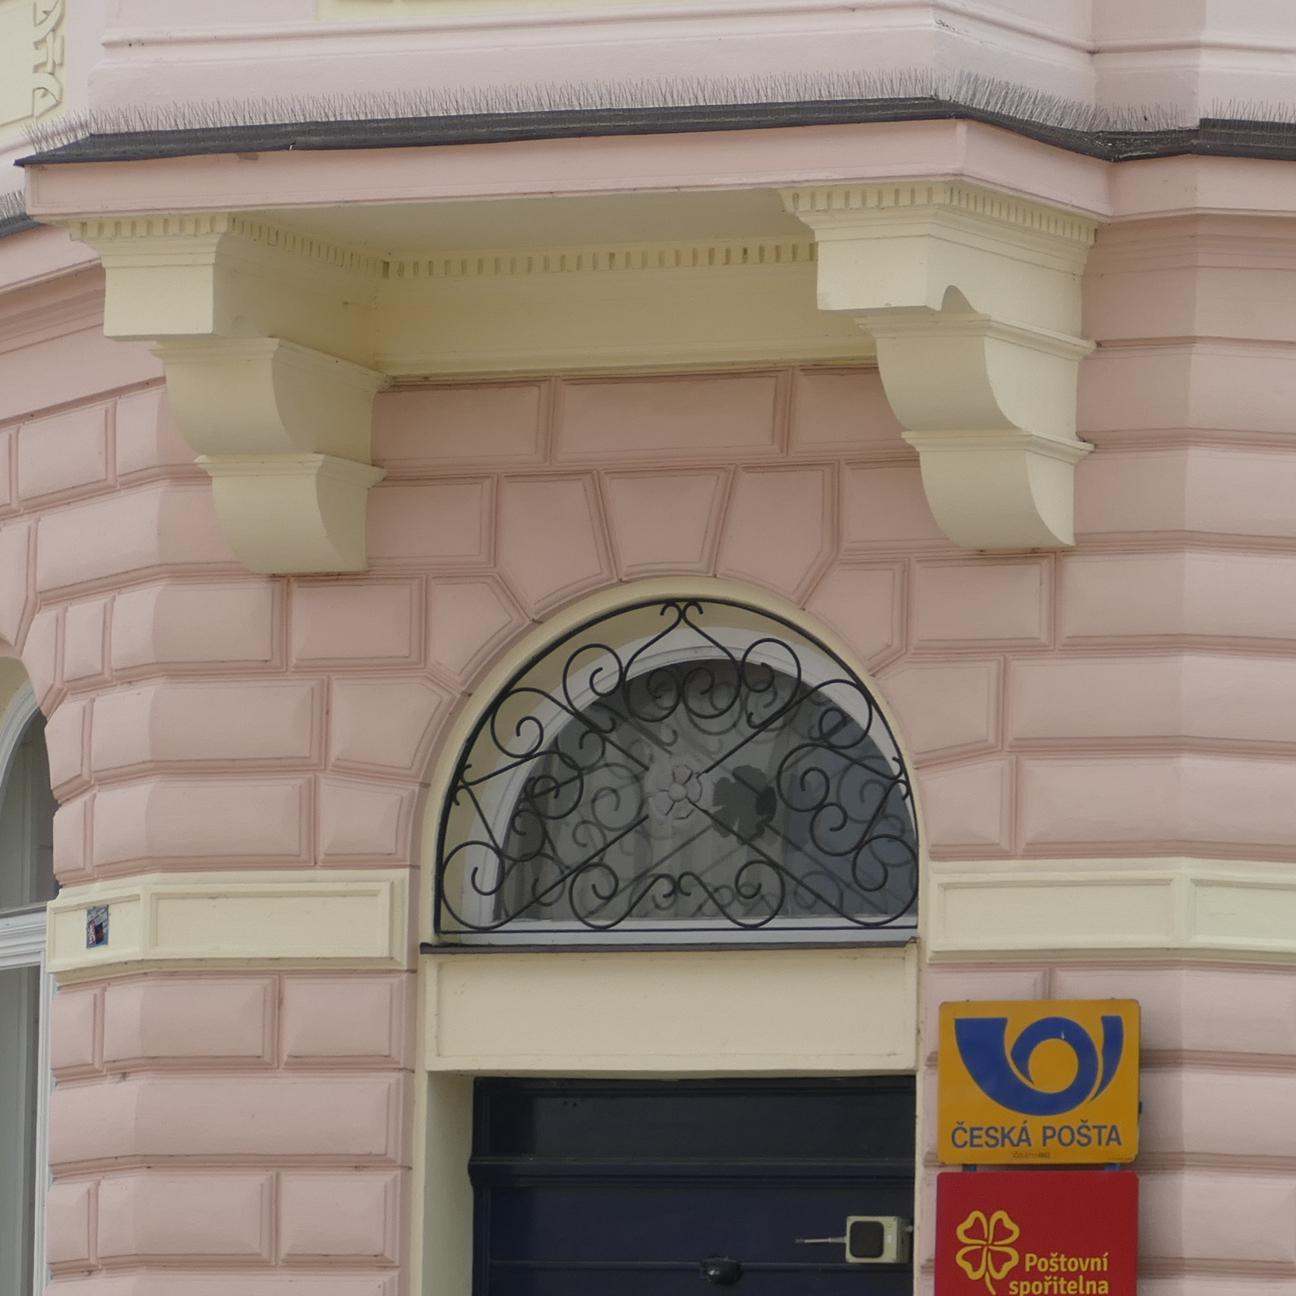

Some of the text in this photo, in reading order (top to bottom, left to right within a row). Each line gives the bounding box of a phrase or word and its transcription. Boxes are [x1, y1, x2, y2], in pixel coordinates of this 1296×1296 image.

[951, 1119, 1122, 1148] ČESKÁ POŠTA
[1024, 1251, 1108, 1272] Poštovní
